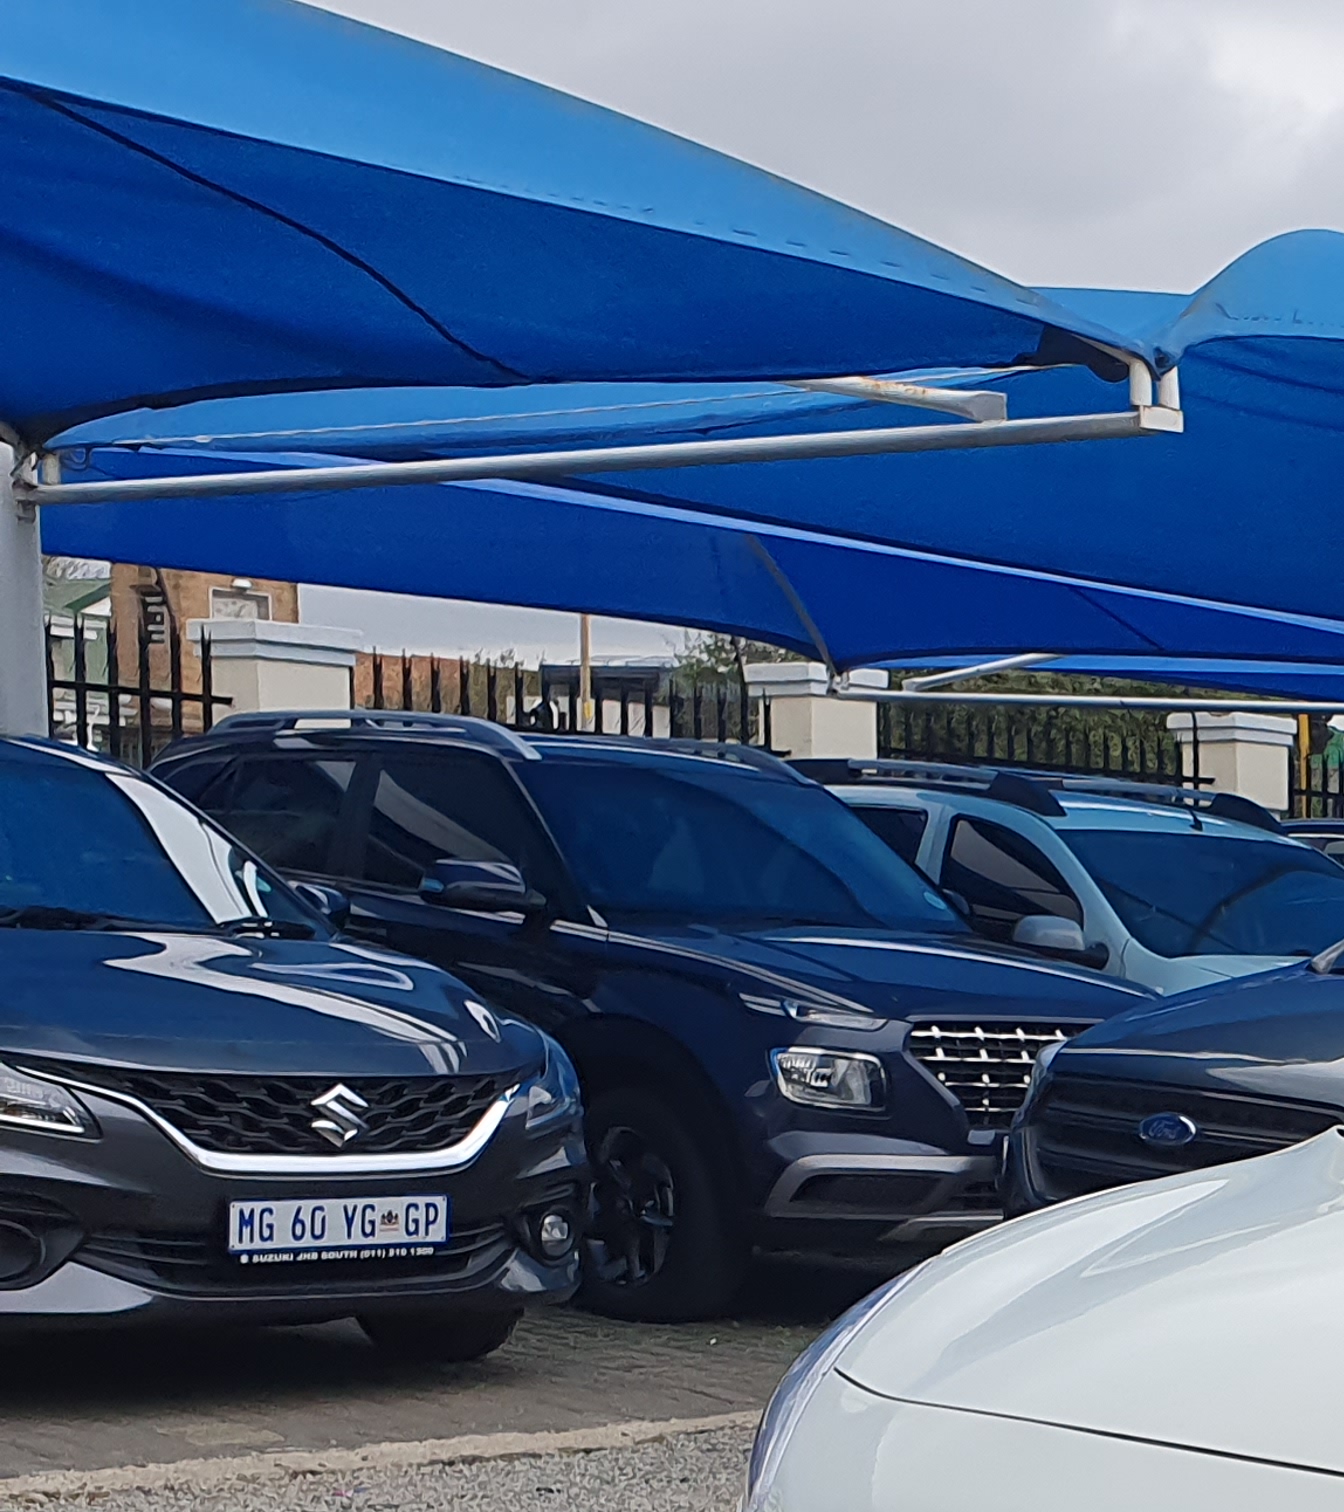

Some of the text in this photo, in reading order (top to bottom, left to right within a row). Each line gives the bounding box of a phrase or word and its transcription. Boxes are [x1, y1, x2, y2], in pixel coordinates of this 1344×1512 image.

[238, 1202, 440, 1244] MG 60 YG GP
